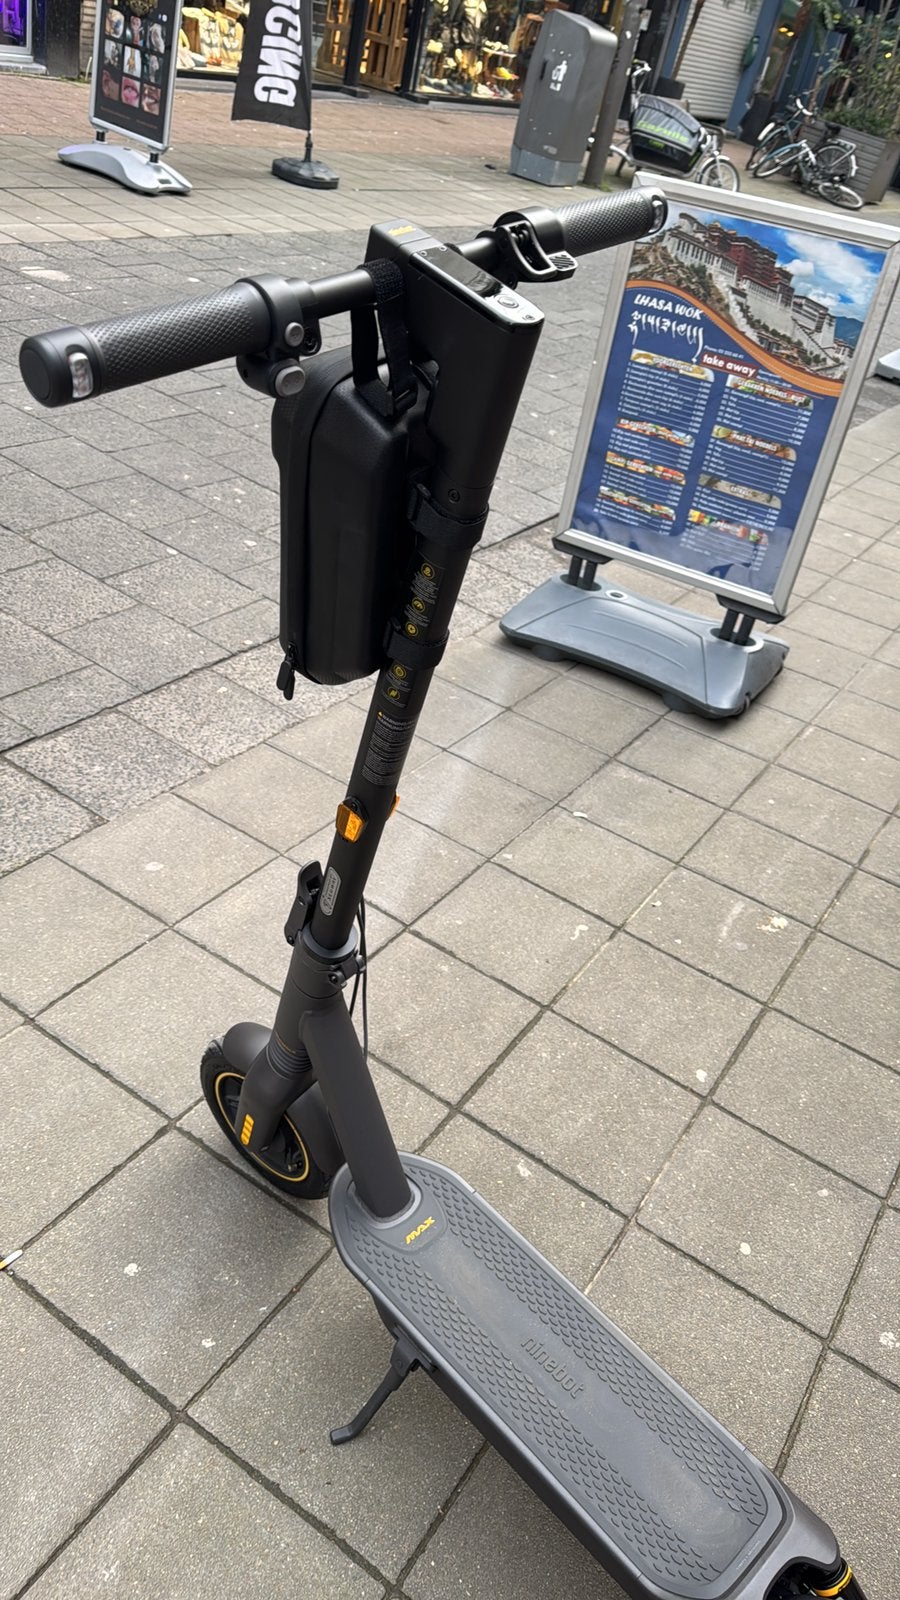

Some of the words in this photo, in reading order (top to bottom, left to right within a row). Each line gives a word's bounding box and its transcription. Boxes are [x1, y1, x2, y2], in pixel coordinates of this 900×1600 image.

[634, 294, 673, 312] LHASA
[674, 303, 704, 320] WOK
[702, 354, 725, 368] take
[726, 362, 756, 377] away
[405, 1216, 435, 1244] MAX
[520, 1338, 584, 1400] ninebot
